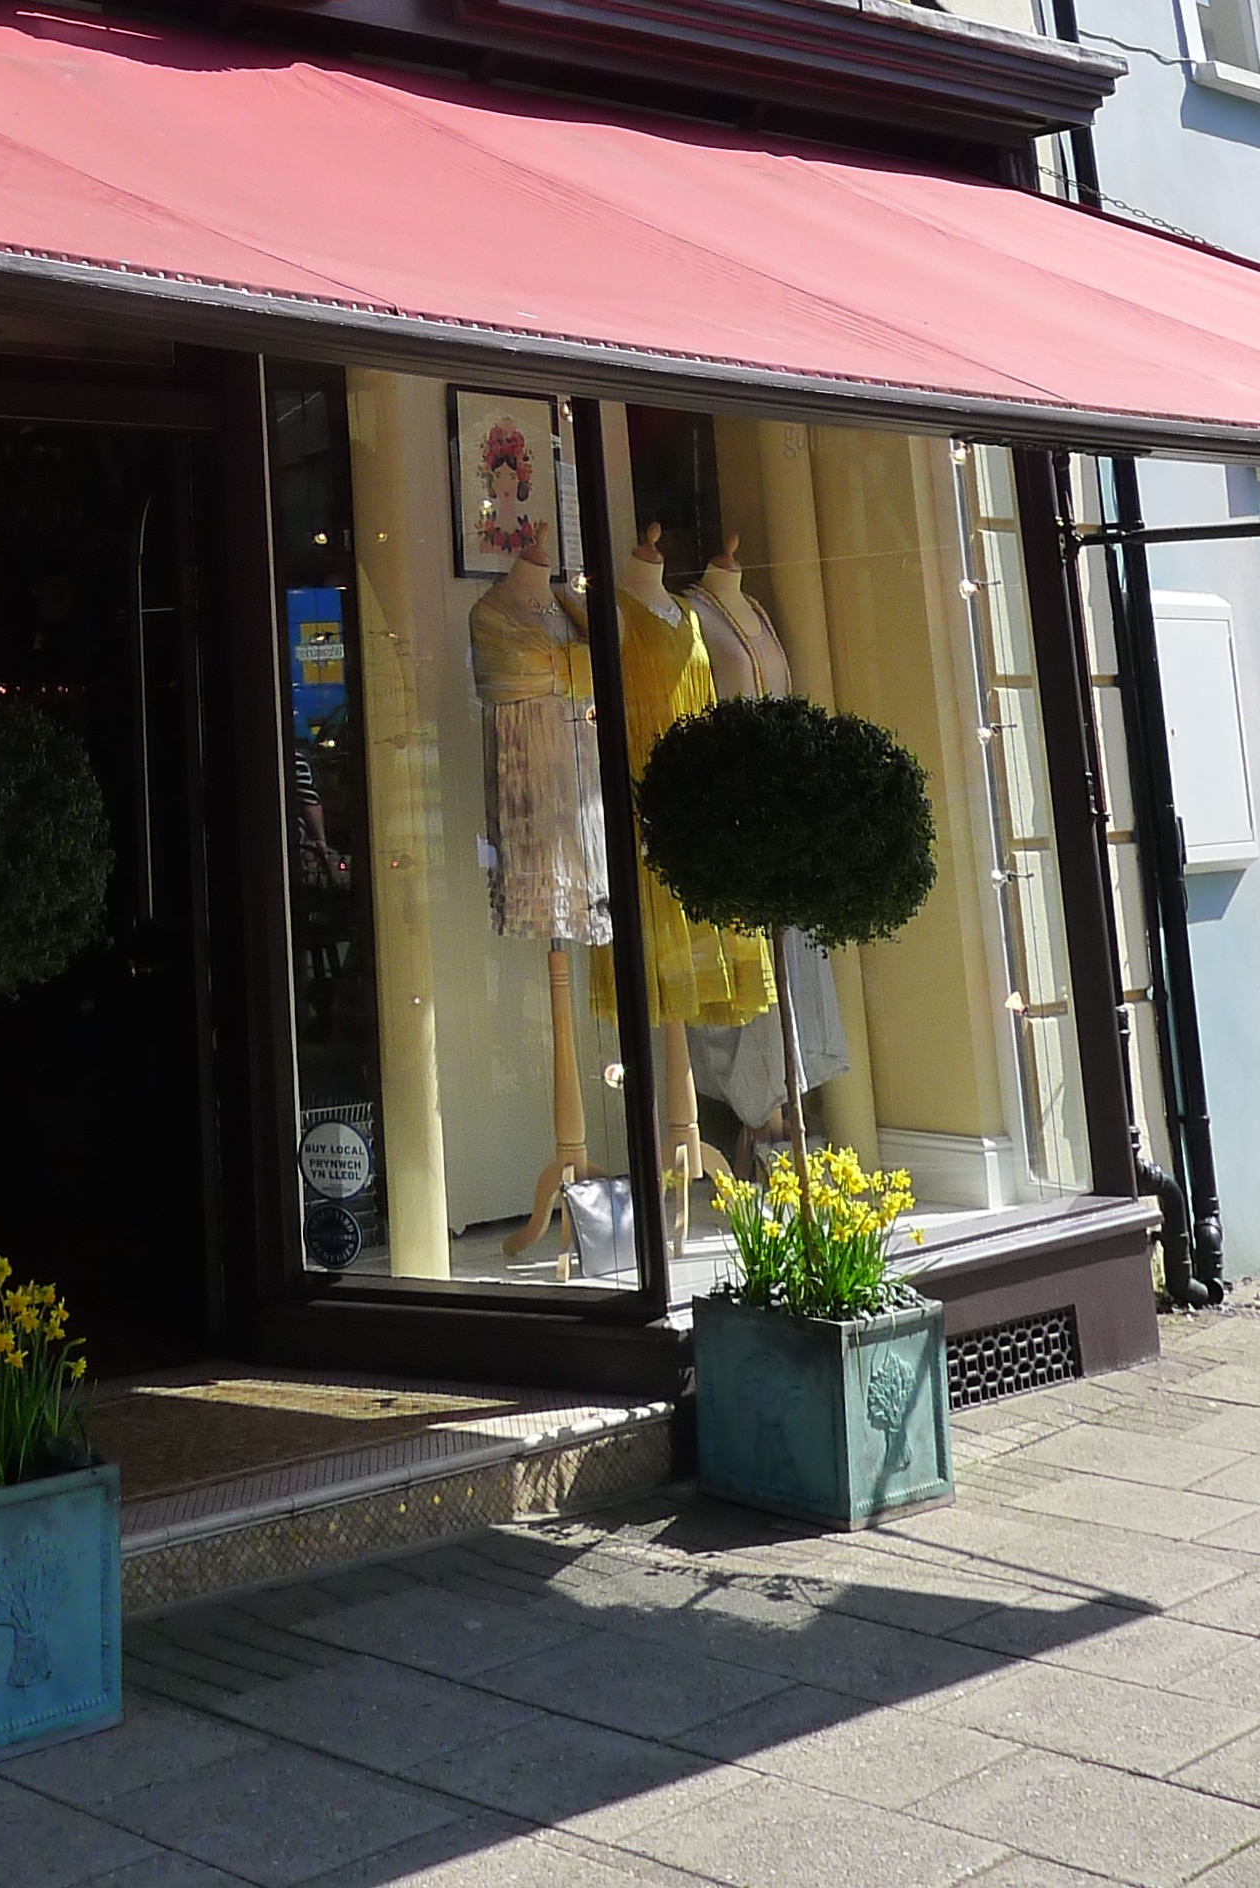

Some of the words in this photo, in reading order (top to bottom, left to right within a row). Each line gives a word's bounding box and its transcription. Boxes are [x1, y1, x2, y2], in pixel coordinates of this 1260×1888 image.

[304, 1143, 326, 1154] BUY
[330, 1144, 365, 1156] LOCAL
[309, 1158, 362, 1170] PRYNWCH
[310, 1169, 326, 1179] YN
[329, 1169, 362, 1180] LLEOL
